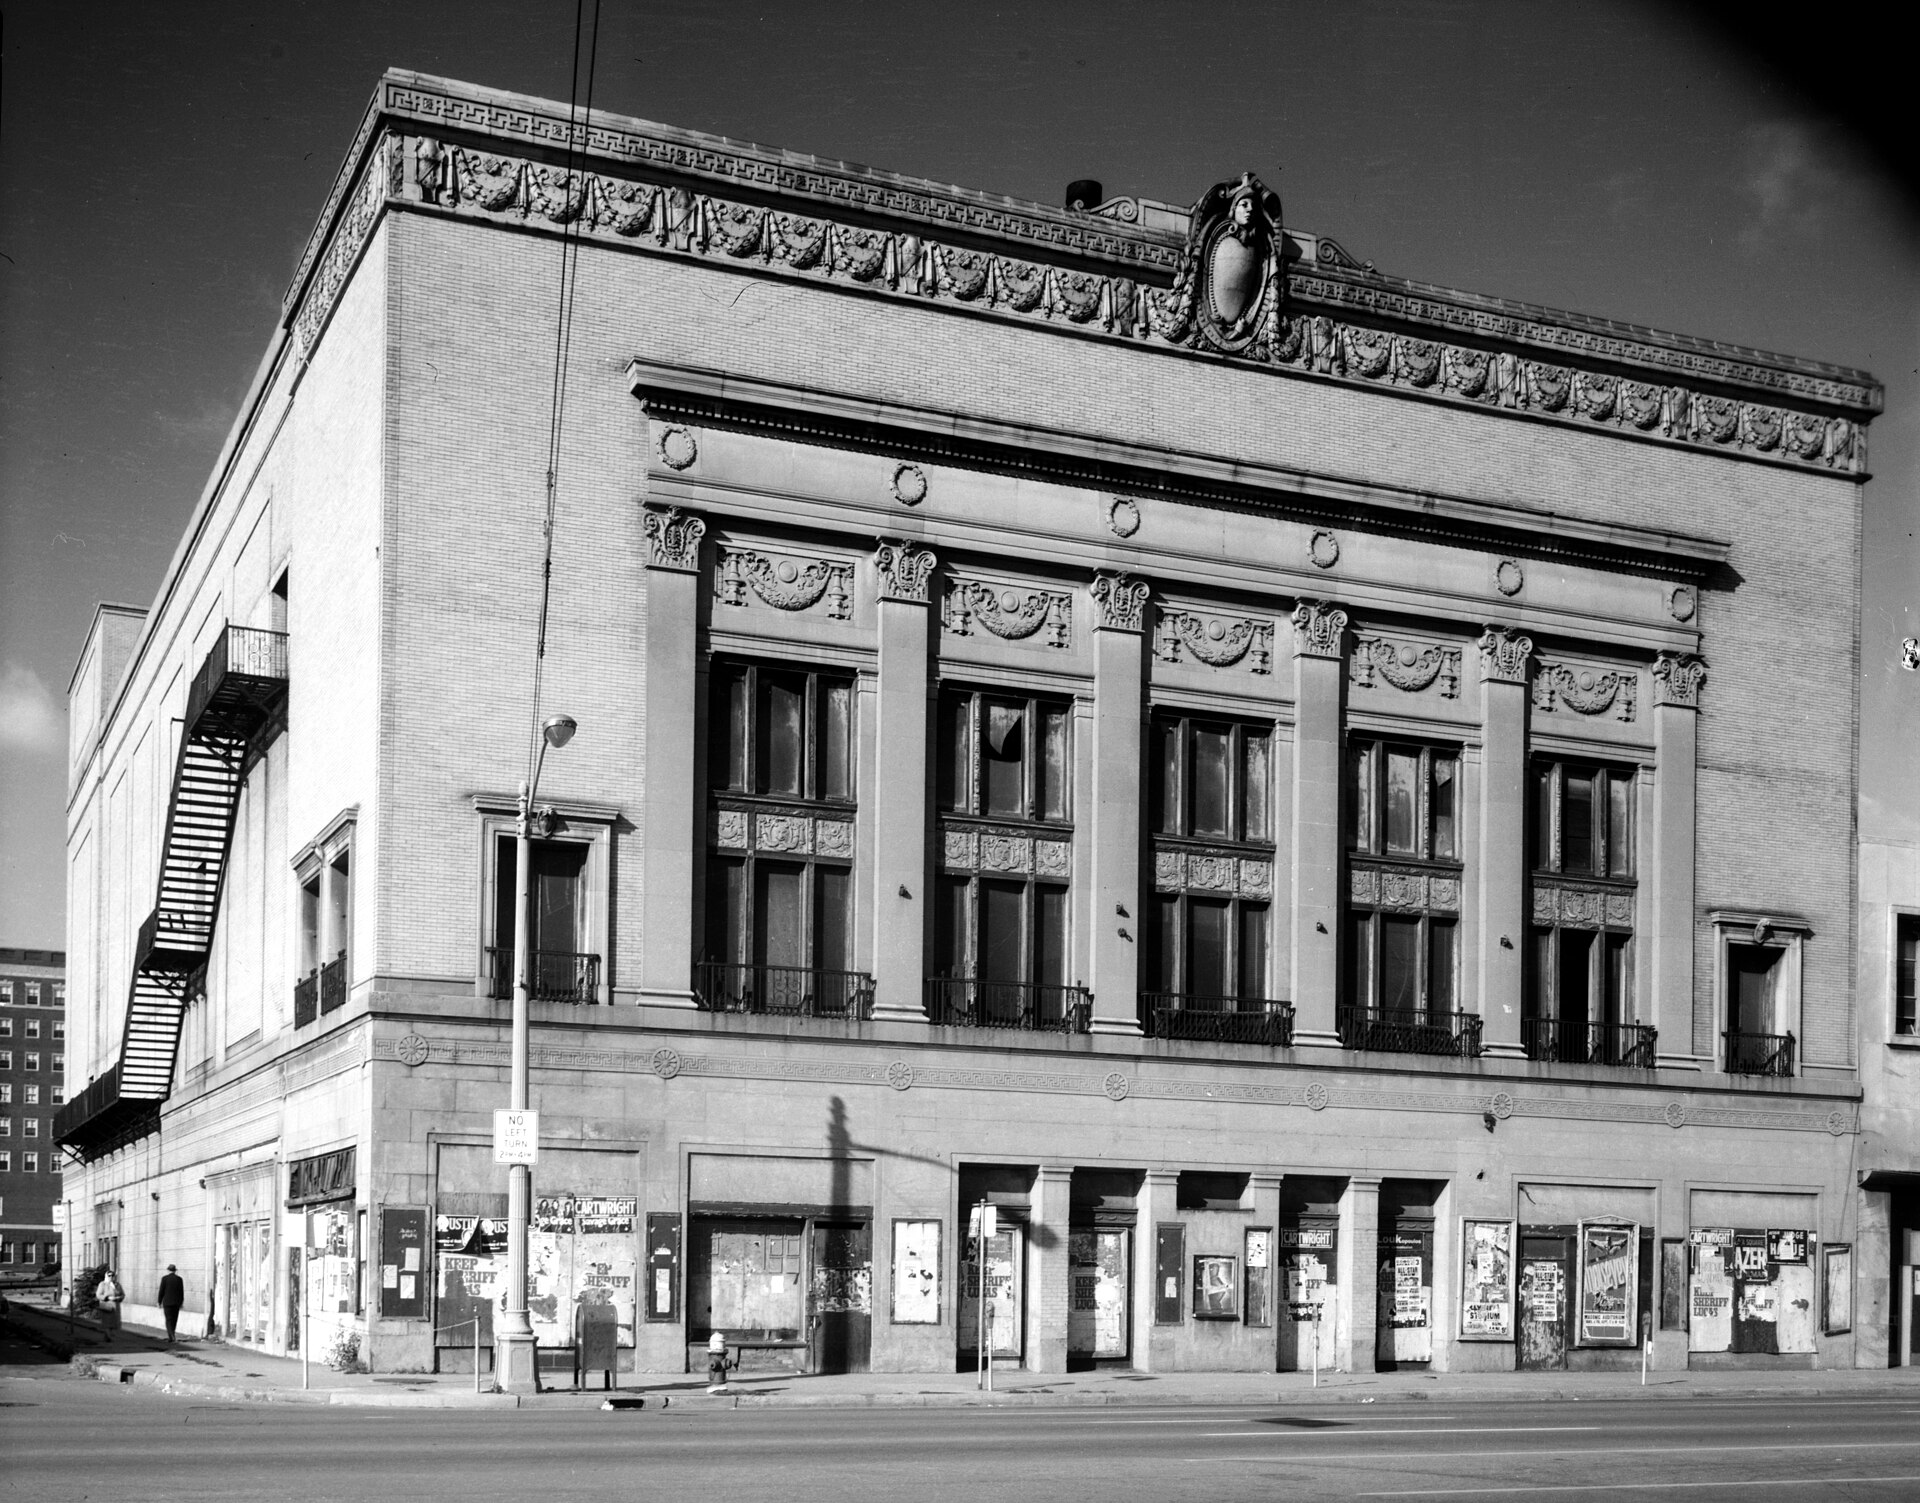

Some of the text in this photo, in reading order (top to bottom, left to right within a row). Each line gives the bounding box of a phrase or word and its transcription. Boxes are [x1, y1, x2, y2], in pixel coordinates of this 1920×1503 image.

[508, 1115, 524, 1125] NO
[505, 1128, 526, 1136] LEFT
[504, 1139, 528, 1148] TURN
[574, 1200, 635, 1215] CARTWRIGHT
[1283, 1232, 1331, 1245] CARTWRIGHT
[1690, 1232, 1731, 1244] CARTWRIGHT
[445, 1258, 478, 1270] KEEP
[1693, 1297, 1729, 1307] SHERIFF
